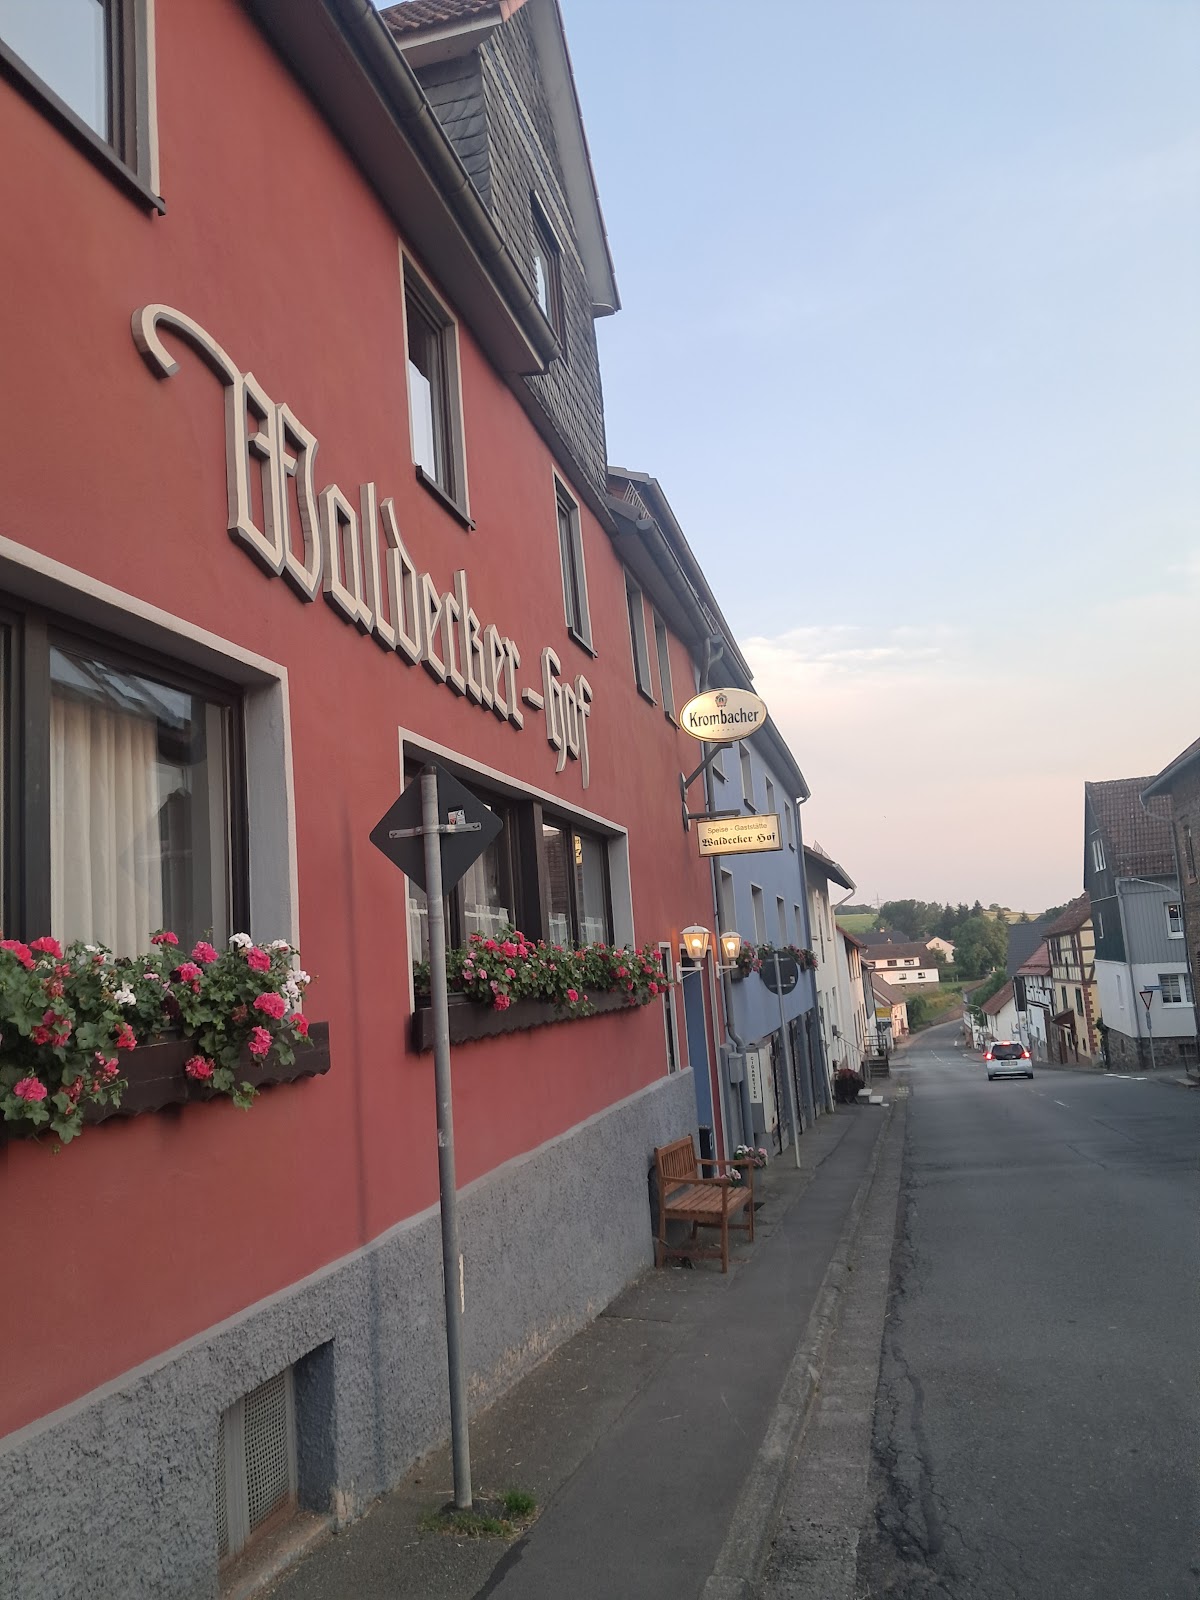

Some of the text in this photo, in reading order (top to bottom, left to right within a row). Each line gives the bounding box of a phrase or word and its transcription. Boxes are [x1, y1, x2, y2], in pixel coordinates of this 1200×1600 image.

[689, 707, 759, 728] Krombacher
[707, 826, 729, 835] Speise
[734, 822, 768, 832] Gaststätte
[701, 831, 776, 848] Waldecker Hof
[750, 1056, 758, 1099] CIGARETTEN
